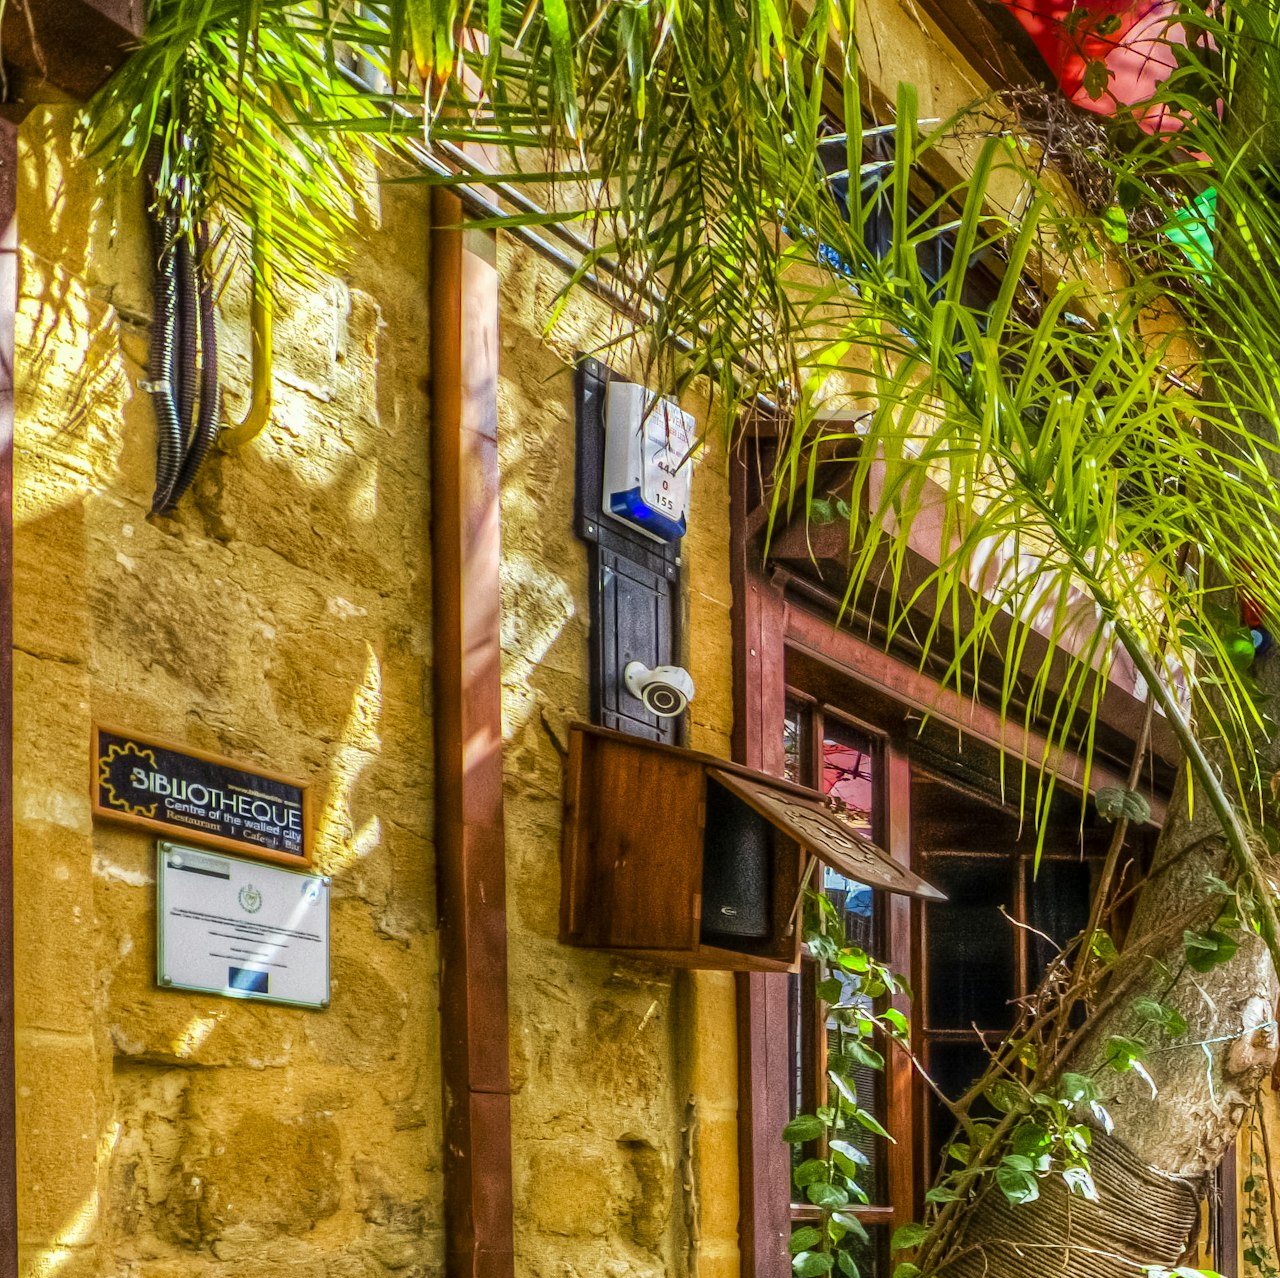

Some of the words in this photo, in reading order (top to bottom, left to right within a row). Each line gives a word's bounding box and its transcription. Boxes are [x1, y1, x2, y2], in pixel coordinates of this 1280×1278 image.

[655, 493, 673, 511] 155
[131, 767, 301, 830] BIBLIOTHEQUE
[164, 797, 206, 816] Centre
[208, 809, 221, 820] of
[223, 811, 242, 827] the
[244, 818, 280, 837] walled
[282, 826, 301, 843] city
[166, 809, 221, 832] Restaurant
